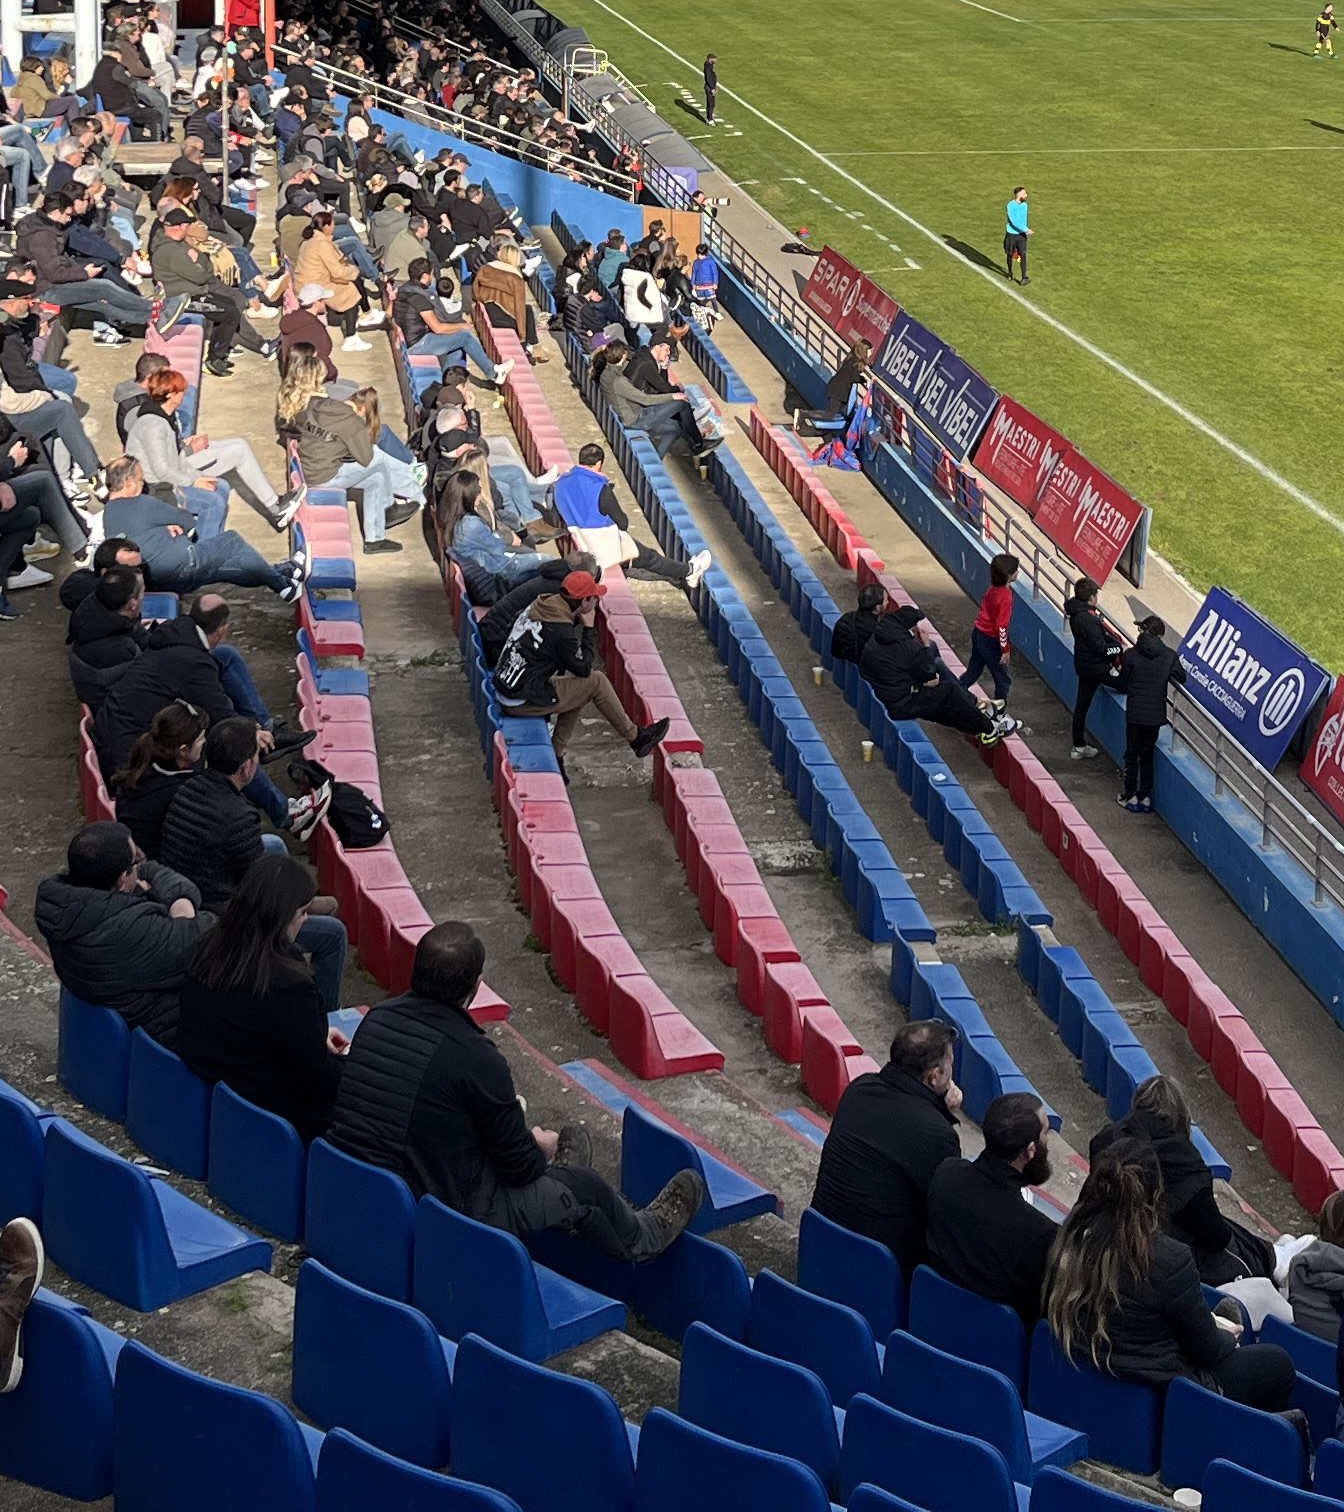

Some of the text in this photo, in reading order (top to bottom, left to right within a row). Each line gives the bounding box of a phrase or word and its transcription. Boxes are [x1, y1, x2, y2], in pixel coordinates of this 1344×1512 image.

[814, 258, 850, 301] SPAR
[880, 324, 920, 388] VIBEL
[938, 378, 980, 450] VIBEL
[989, 404, 1041, 465] MAESTRI
[1036, 438, 1082, 502] MESTRI
[1072, 476, 1131, 543] MAESTRI
[1186, 609, 1272, 705] Allianz
